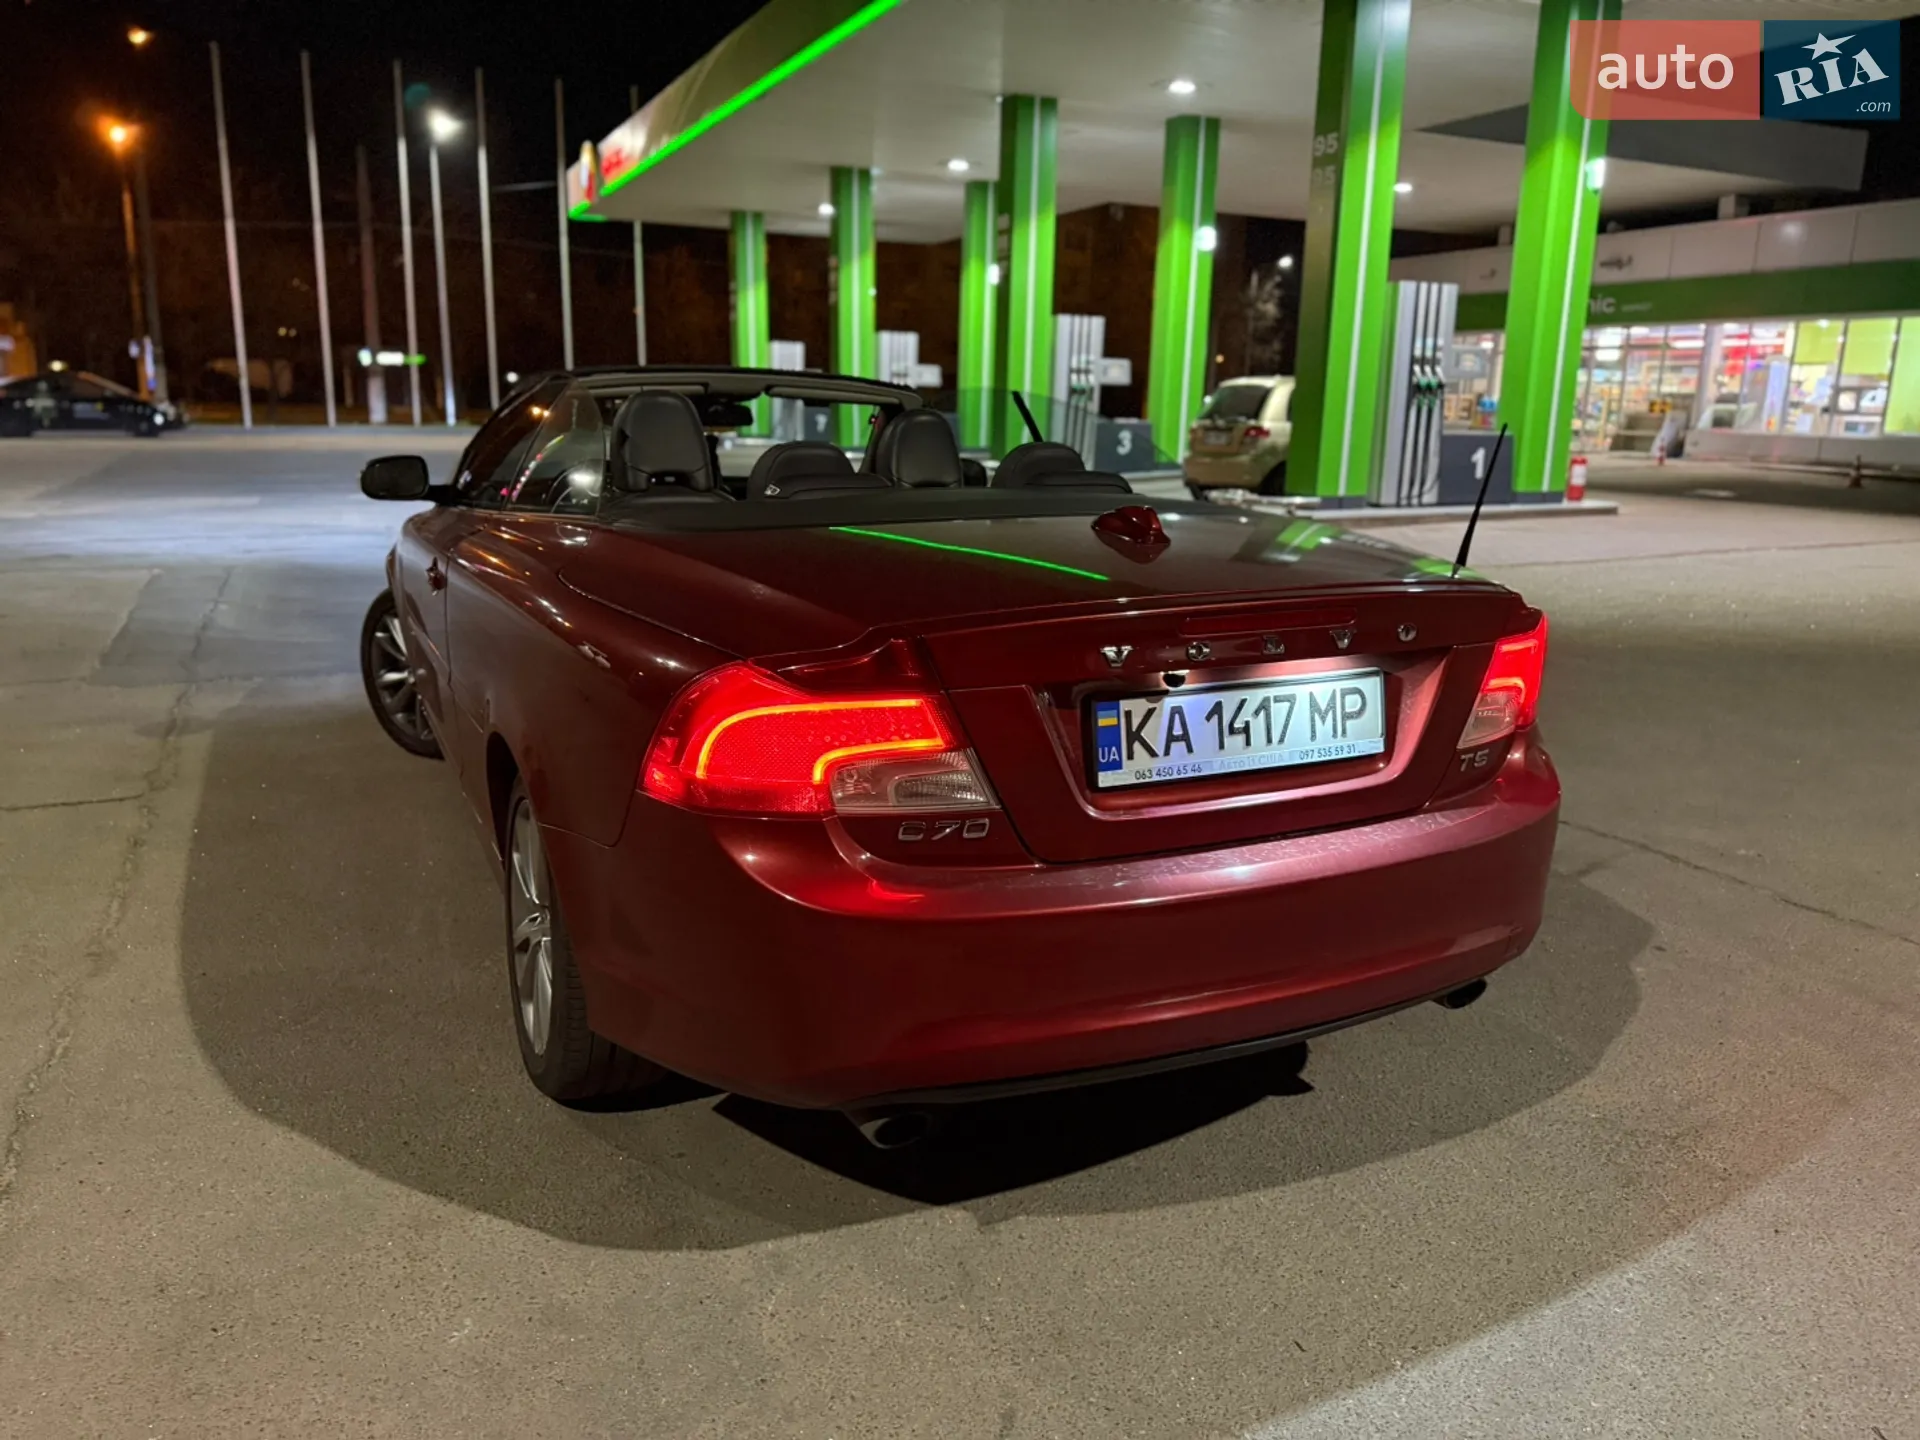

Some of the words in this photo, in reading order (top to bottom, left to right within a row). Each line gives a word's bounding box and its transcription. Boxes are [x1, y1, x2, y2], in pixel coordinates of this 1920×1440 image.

[1313, 131, 1339, 156] 95
[1115, 430, 1133, 454] 3
[1471, 446, 1487, 480] 1
[1100, 623, 1418, 667] VOLVO
[1204, 694, 1296, 750] 1417
[1098, 746, 1120, 763] UA
[1298, 749, 1314, 761] 097
[1317, 747, 1332, 758] 535
[1334, 745, 1345, 756] 59
[1346, 743, 1356, 754] 31
[1459, 748, 1490, 772] T5
[1134, 768, 1153, 780] 063
[1155, 766, 1174, 777] 450
[1176, 765, 1188, 775] 65
[1190, 763, 1203, 774] 46
[897, 817, 990, 841] C70
